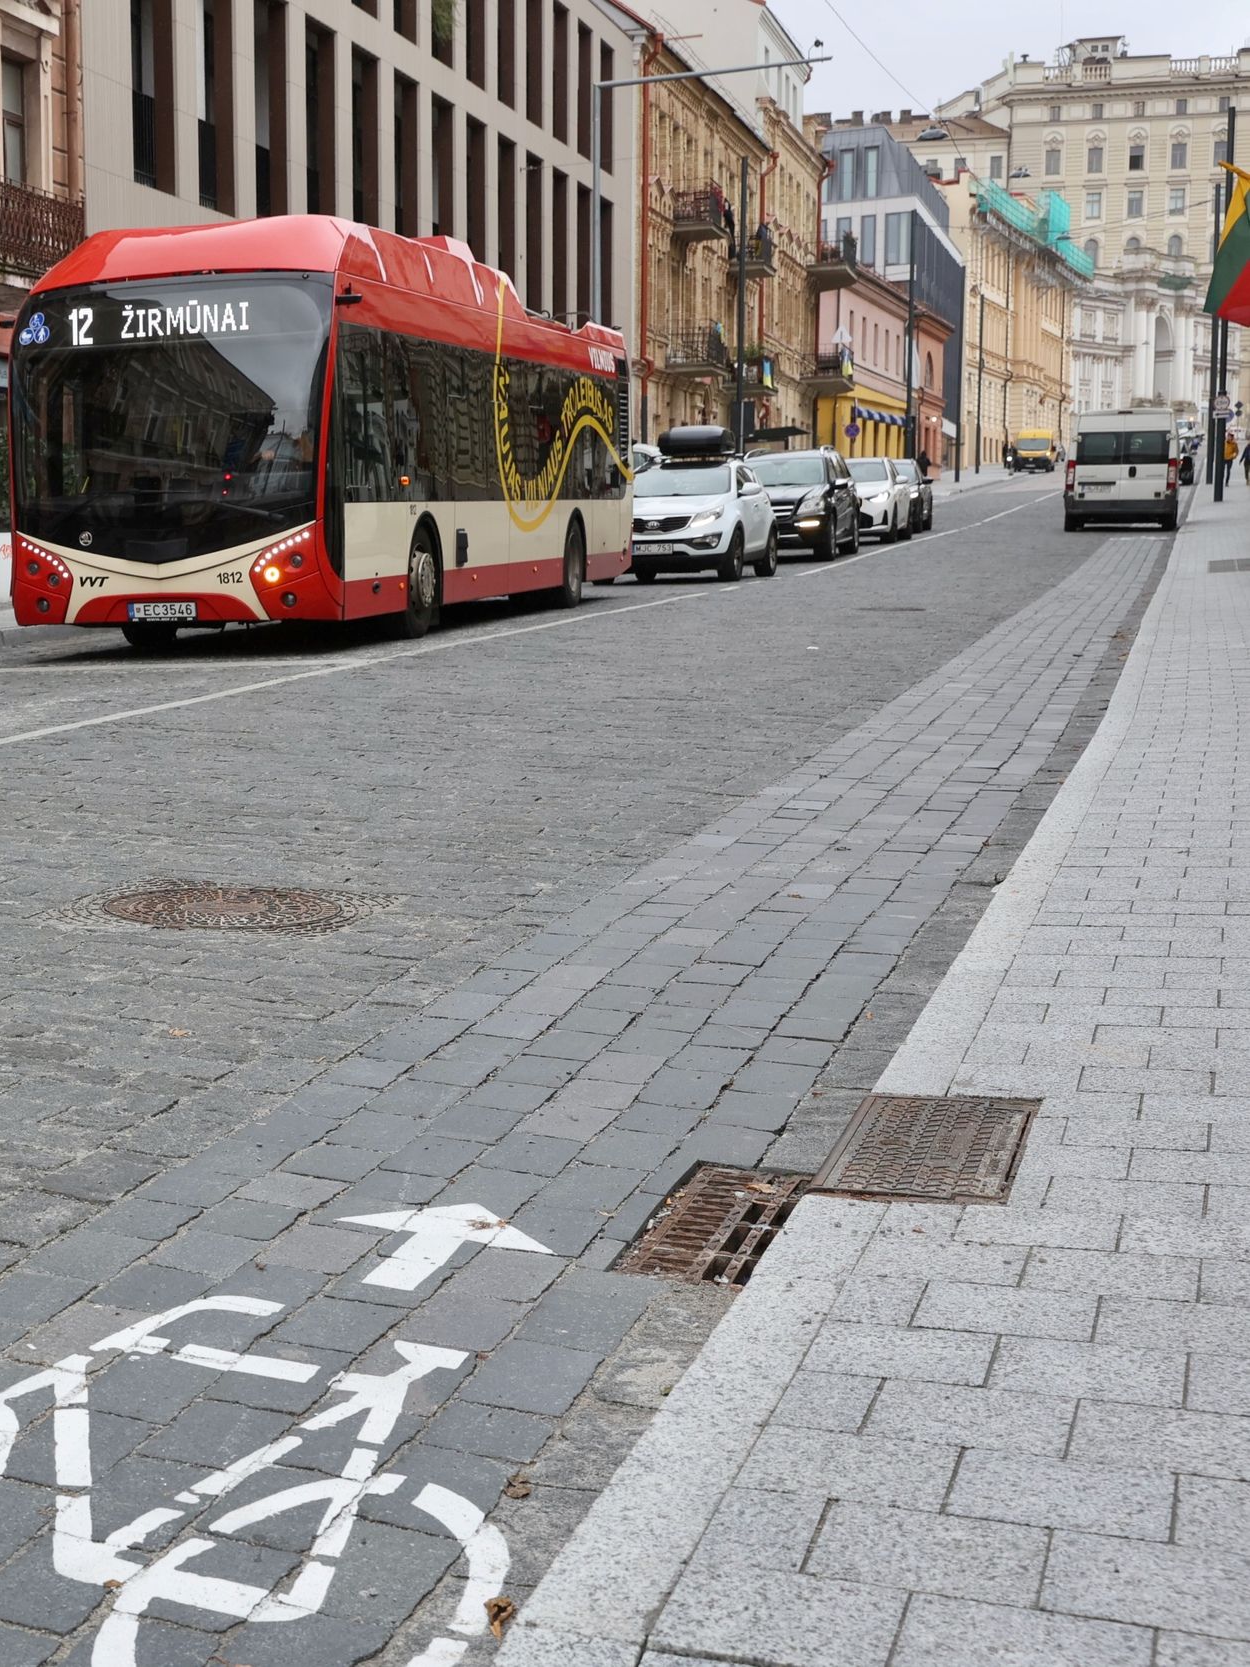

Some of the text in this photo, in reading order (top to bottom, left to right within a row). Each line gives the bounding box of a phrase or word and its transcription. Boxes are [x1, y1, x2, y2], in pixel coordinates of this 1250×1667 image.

[68, 299, 250, 346] 12 ŽIRMŪNAI
[587, 345, 616, 374] VILNIUS
[523, 429, 563, 513] VILNIAUS
[560, 376, 614, 437] TROLEIBUSAS
[79, 576, 110, 588] VVT
[216, 571, 244, 585] 1812
[143, 603, 193, 617] EC3546
